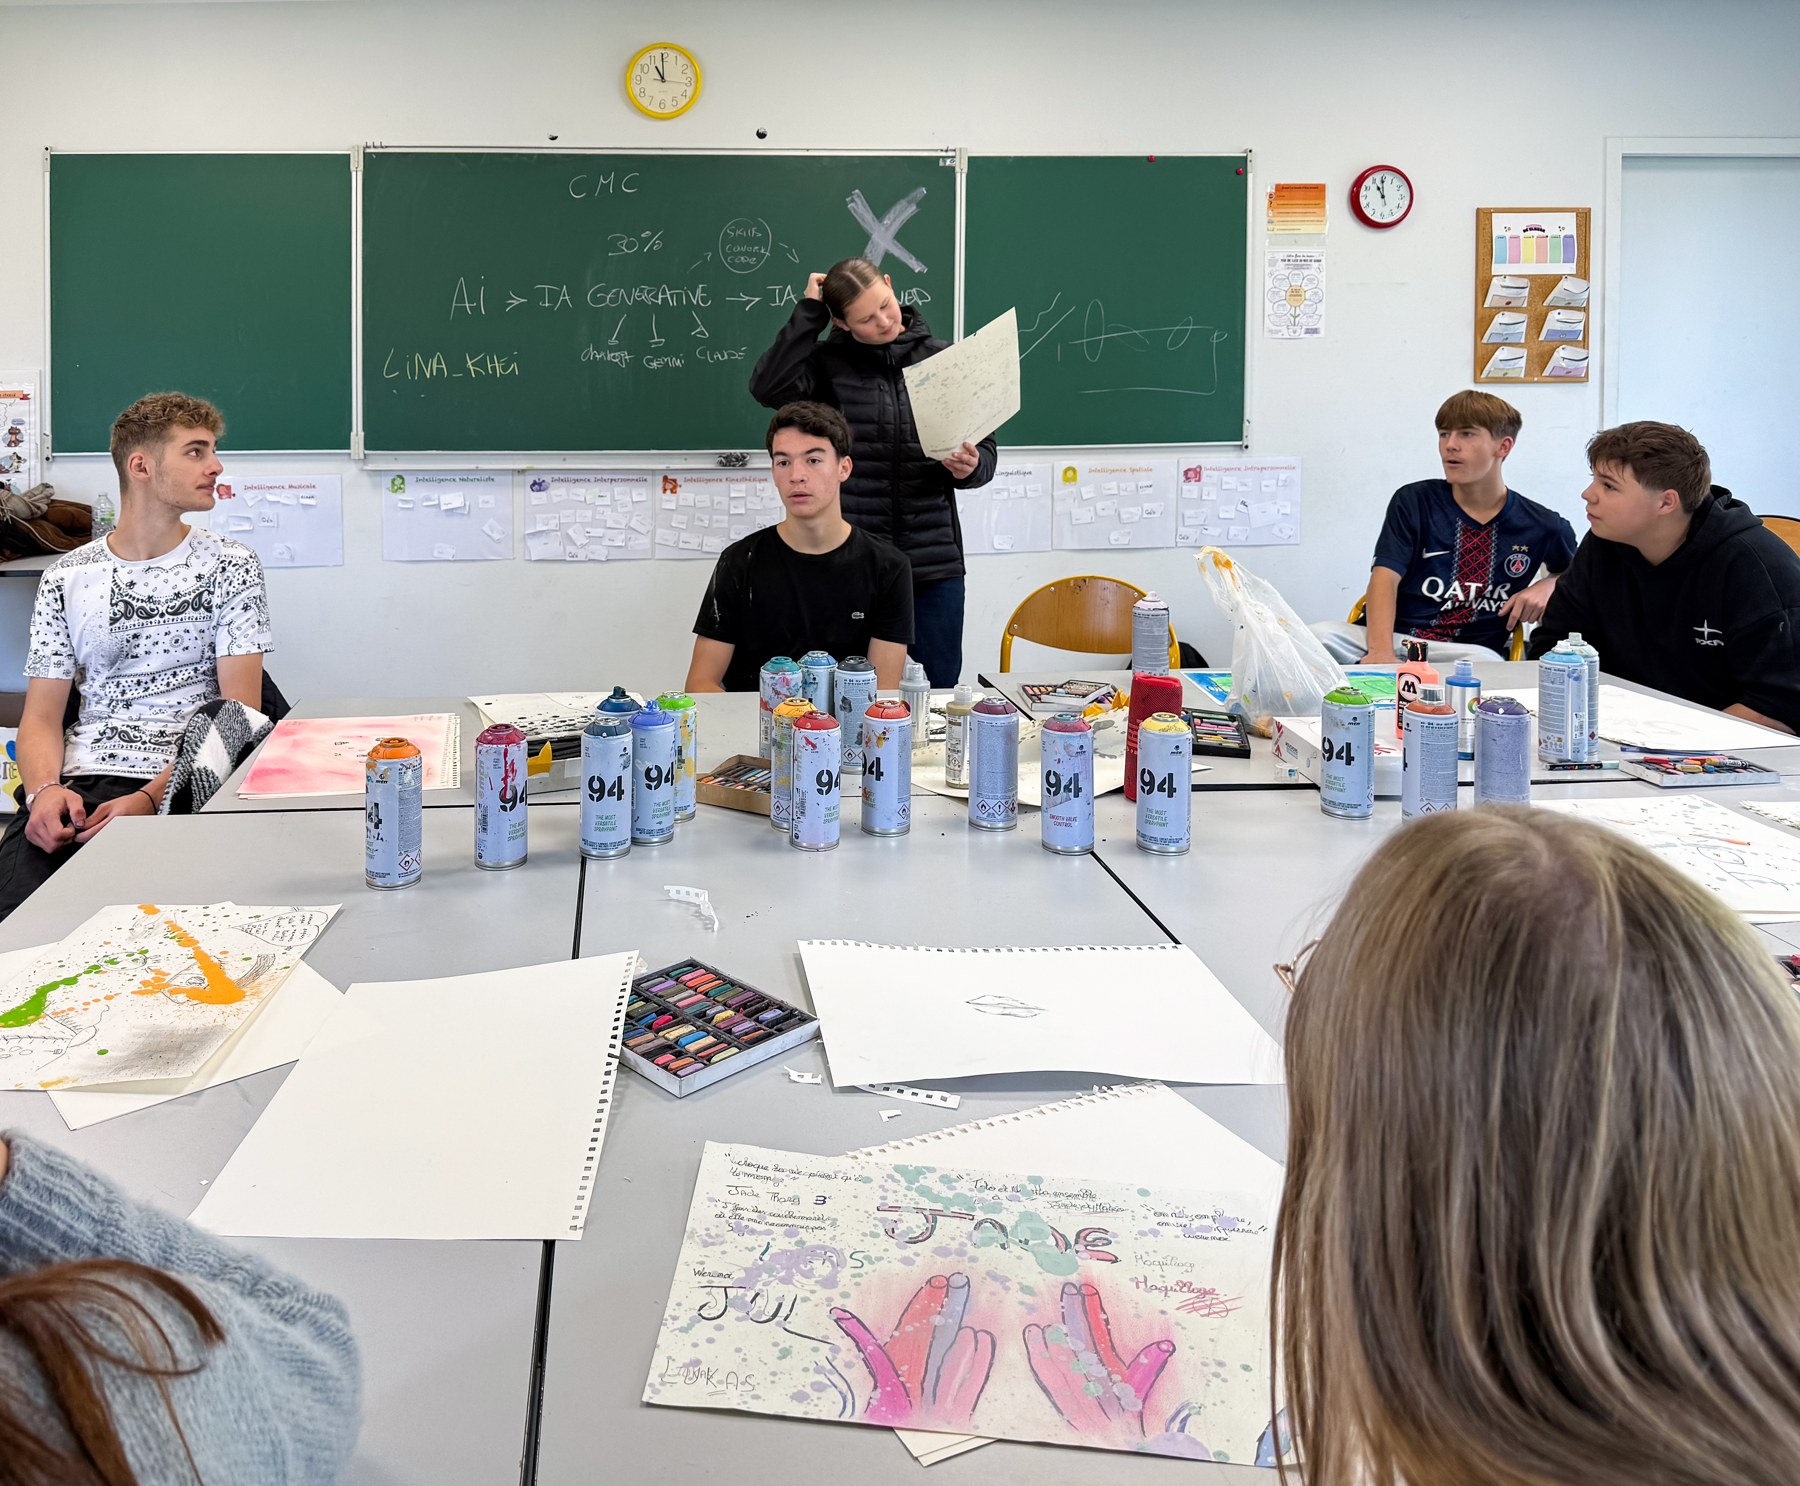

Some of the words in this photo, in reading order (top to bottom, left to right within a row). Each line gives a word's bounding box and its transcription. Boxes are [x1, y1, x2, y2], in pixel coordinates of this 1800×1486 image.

[649, 55, 656, 66] 11
[640, 63, 650, 74] 10
[681, 64, 689, 75] 2
[634, 74, 642, 85] 9
[684, 76, 692, 87] 3
[638, 87, 646, 97] 8
[681, 89, 687, 99] 4
[648, 95, 654, 106] 7
[658, 98, 666, 109] 6
[671, 96, 678, 107] 5
[569, 172, 641, 199] CMC
[608, 230, 664, 256] 30%
[1088, 467, 1127, 475] Intelligence
[1129, 466, 1153, 474] Spatiale
[1203, 465, 1243, 473] Intelligence
[1244, 464, 1297, 473] Intrapersonnelle
[415, 476, 457, 484] Intelligence
[551, 476, 592, 484] Intelligence
[594, 476, 648, 484] Interpersonnelle
[683, 476, 724, 484] Intelligence
[243, 484, 286, 492] Intelligence
[1421, 576, 1511, 602] QATAR
[1402, 680, 1417, 694] M
[1322, 736, 1355, 766] 94
[644, 762, 674, 791] 94
[588, 775, 624, 802] 94
[1045, 770, 1082, 798] 94
[1140, 768, 1177, 798] 94
